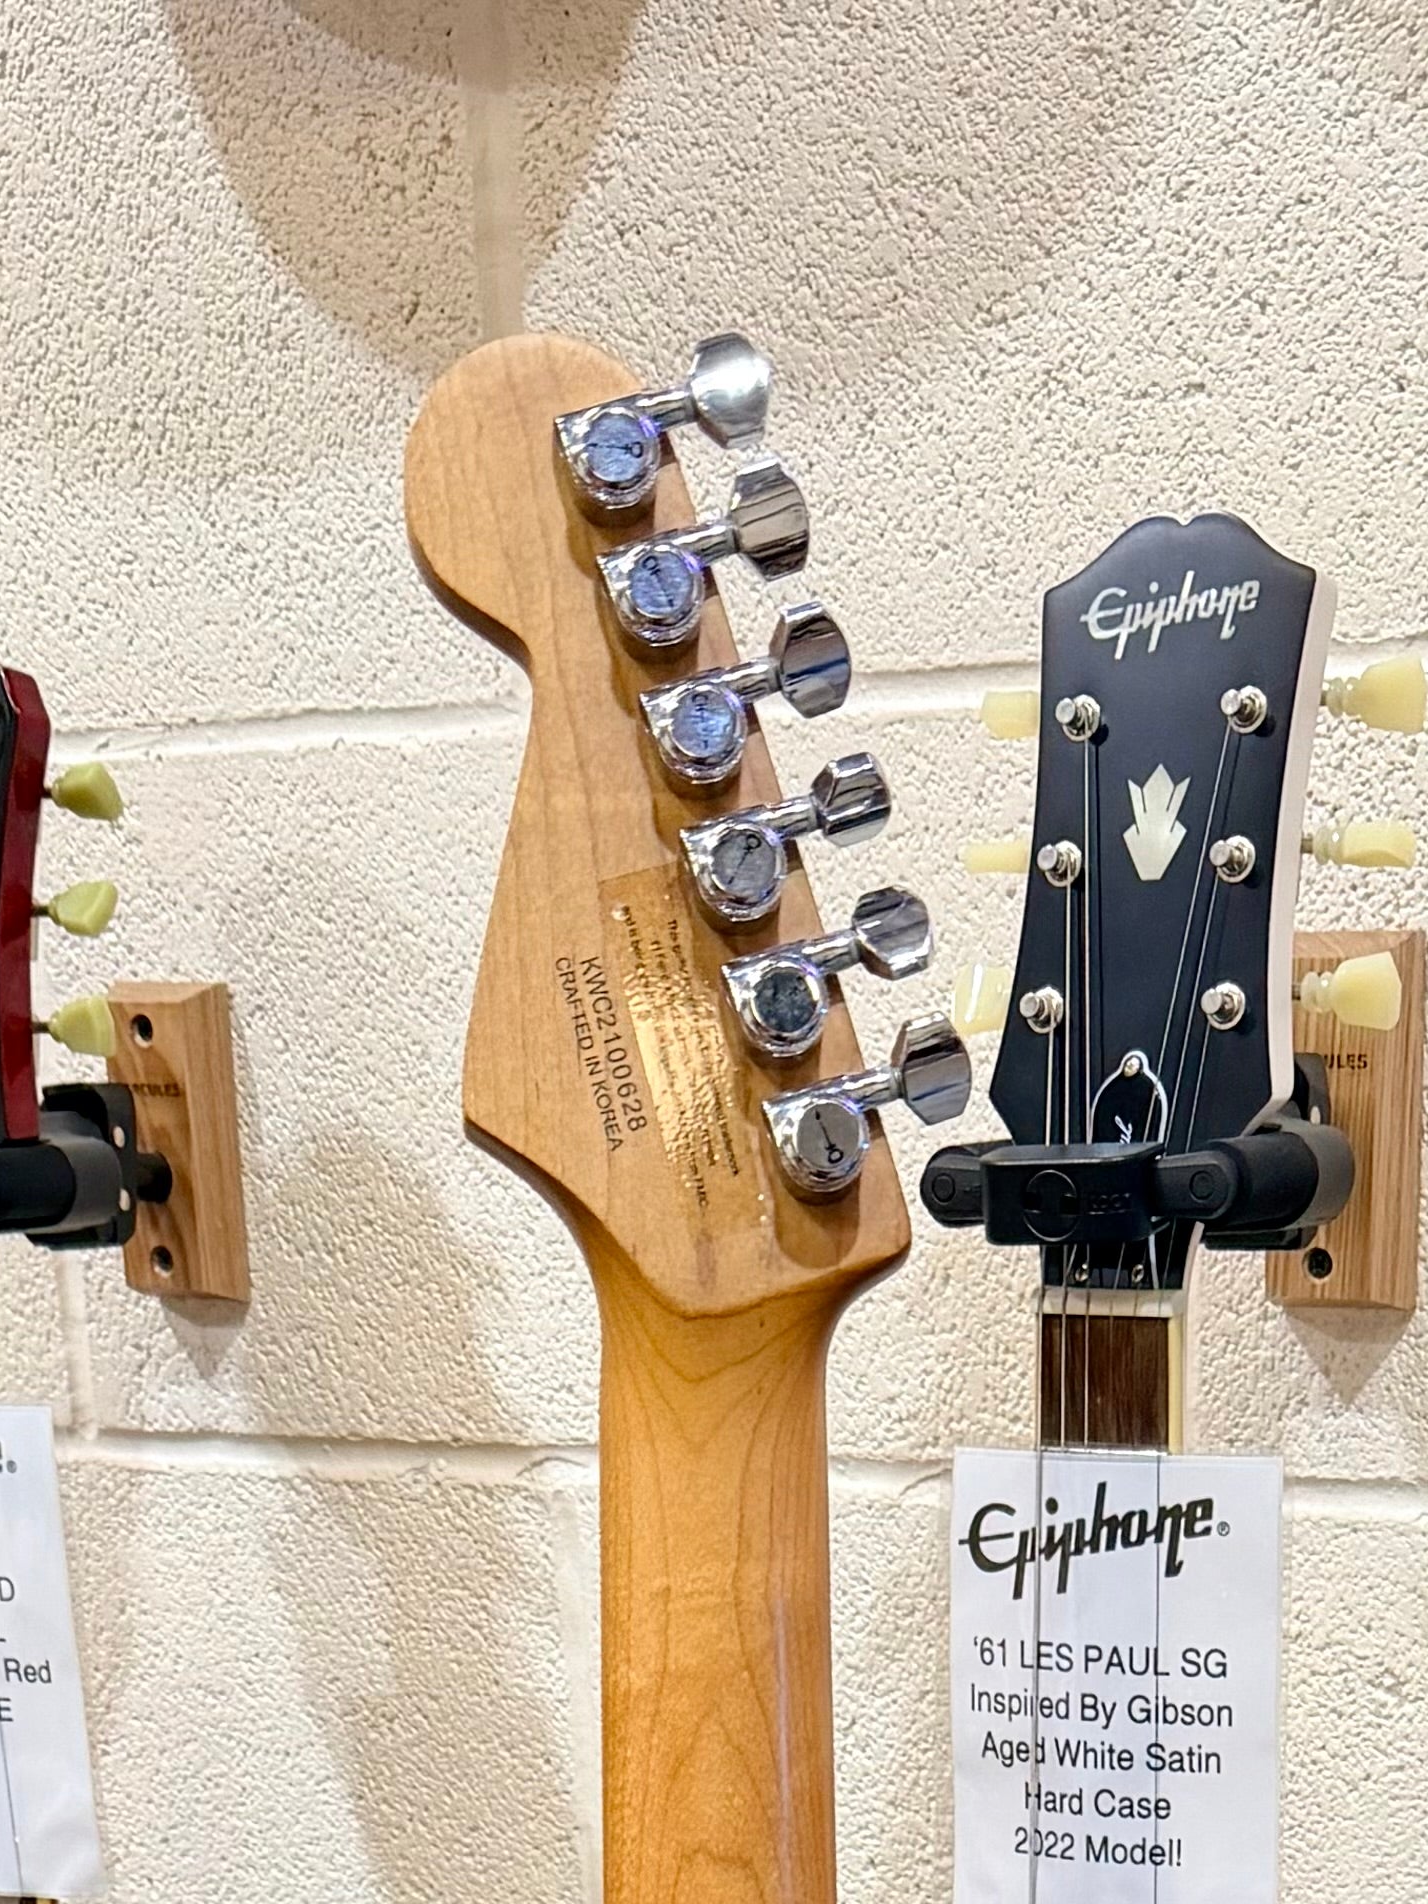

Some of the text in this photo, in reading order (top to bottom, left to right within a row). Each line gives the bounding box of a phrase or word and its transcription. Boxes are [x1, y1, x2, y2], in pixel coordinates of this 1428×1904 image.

[1079, 569, 1261, 661] Epiphone
[556, 957, 625, 1152] CRAFTED IN KOREA
[581, 956, 648, 1133] KWC2100628
[958, 1480, 1215, 1600] Epiphone
[3, 1659, 53, 1685] Red
[1019, 1640, 1075, 1675] LES
[1083, 1643, 1172, 1677] PAUL
[1180, 1647, 1229, 1680] SG
[970, 1683, 1235, 1731] Inspired By Gibson
[981, 1731, 1223, 1776] Aged White Satin
[1024, 1783, 1172, 1822] Hard Case
[1013, 1827, 1184, 1868] 2022 Model!
